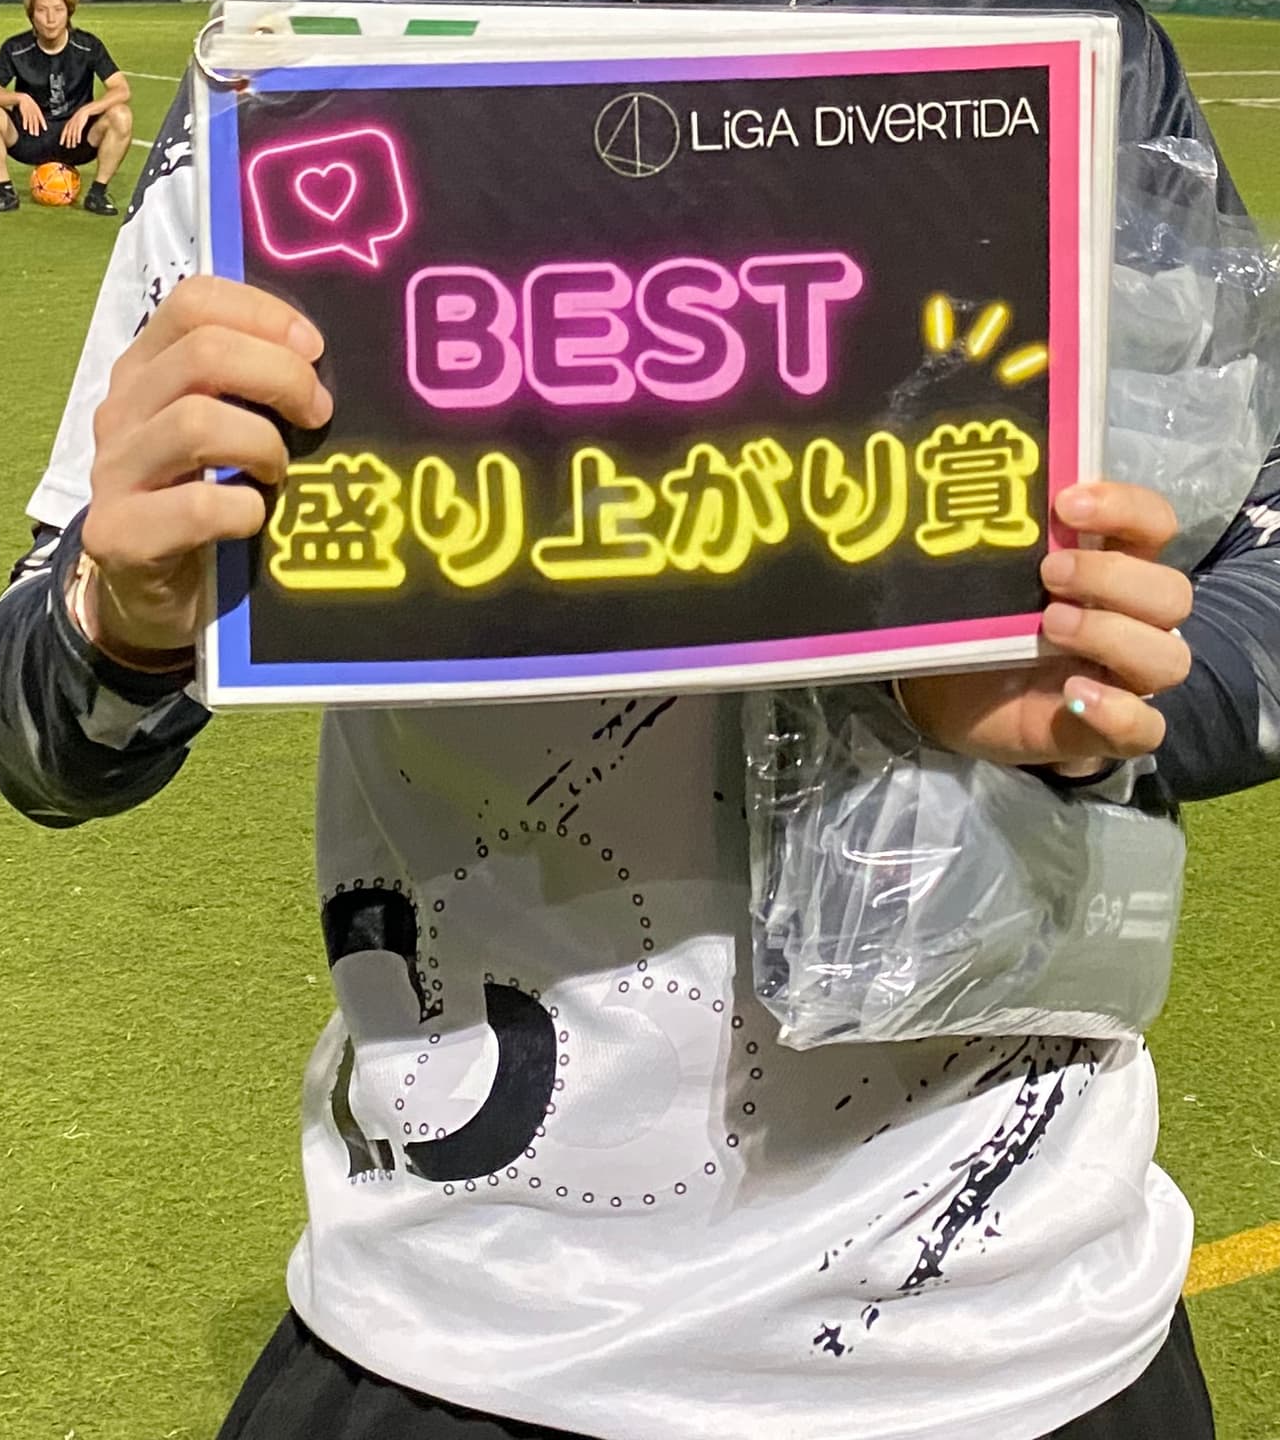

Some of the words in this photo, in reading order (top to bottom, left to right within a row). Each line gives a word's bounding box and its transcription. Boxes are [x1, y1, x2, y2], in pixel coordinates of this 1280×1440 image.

[405, 250, 864, 410] BEST
[267, 418, 1040, 590] 盛り上がり賞
